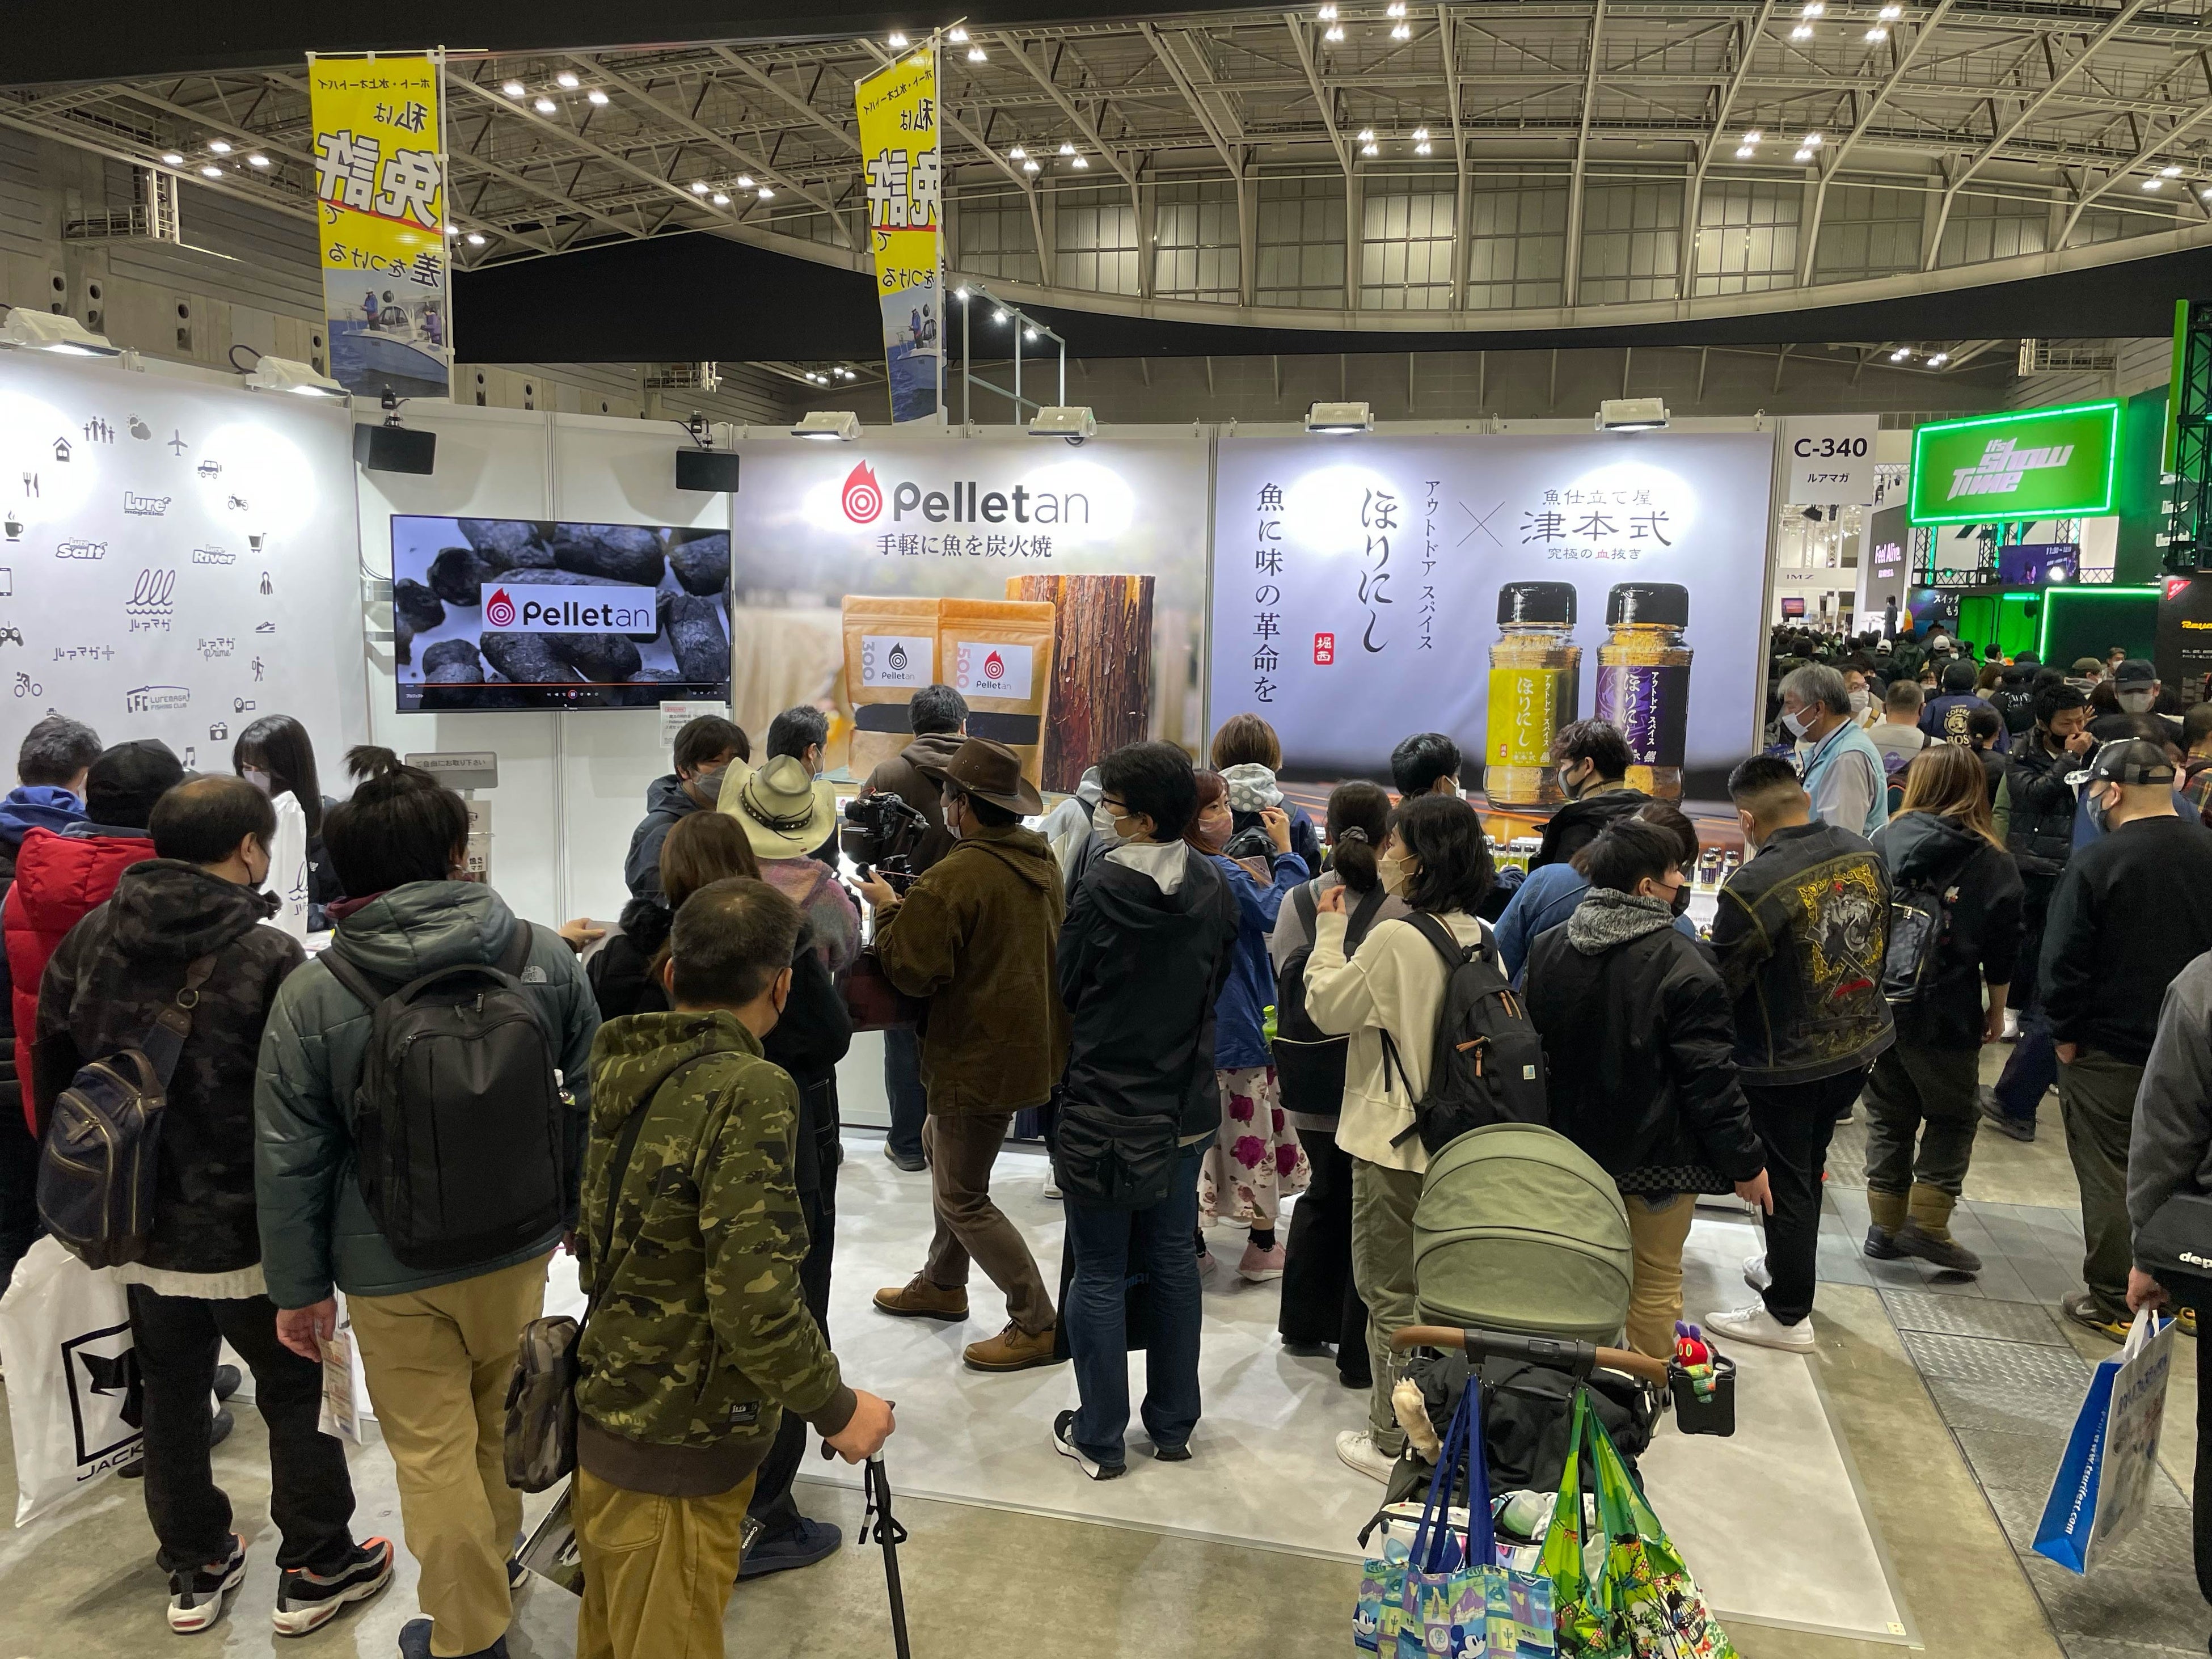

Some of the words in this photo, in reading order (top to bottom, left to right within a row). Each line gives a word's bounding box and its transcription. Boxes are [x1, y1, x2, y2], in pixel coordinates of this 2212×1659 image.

[1794, 438, 1868, 457] C-340
[1808, 473, 1850, 483] ルアマガ
[124, 491, 168, 512] Lure
[893, 482, 1088, 524] Pelletan
[1542, 489, 1652, 506] 魚仕立て屋
[1421, 480, 1441, 577] アウトドア
[1519, 510, 1671, 546] 津本式
[56, 543, 107, 559] Salt
[192, 550, 236, 564] River
[876, 533, 1052, 558] 手軽に魚を炭火焼
[1547, 548, 1641, 560] 究極の血抜き
[1358, 487, 1399, 653] ほりにし
[1252, 482, 1284, 703] 魚に味の革命を
[129, 619, 171, 632] ルアマガ
[523, 601, 650, 627] Pelletan
[1417, 585, 1436, 650] スパイス
[863, 641, 875, 681] 300
[1316, 636, 1332, 662] 堀西
[882, 672, 915, 680] Pelletan
[956, 647, 971, 689] 500
[976, 681, 1012, 690] Pelletan
[1516, 676, 1534, 747] ほりにし
